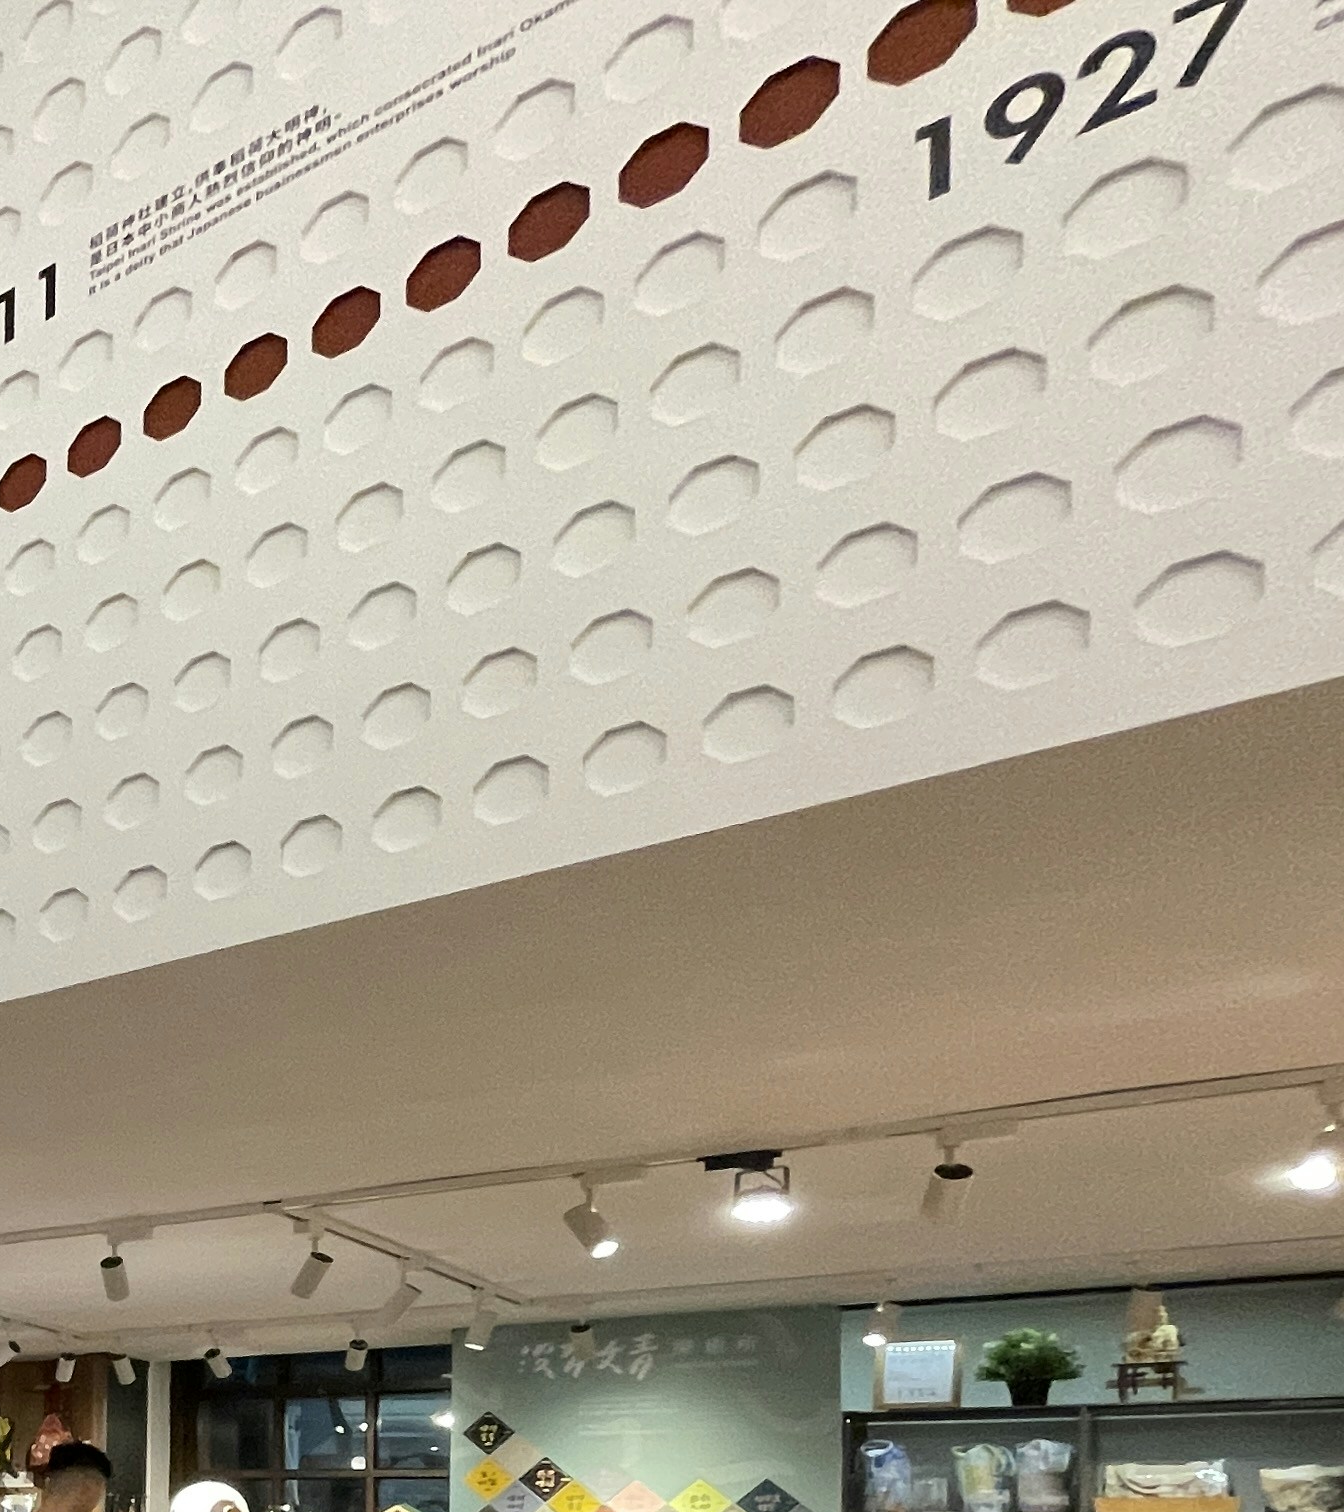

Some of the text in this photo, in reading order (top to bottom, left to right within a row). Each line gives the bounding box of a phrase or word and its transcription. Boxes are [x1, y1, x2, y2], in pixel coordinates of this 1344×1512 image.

[90, 254, 124, 280] Taipei
[128, 235, 156, 259] Inari
[160, 211, 202, 241] Shrine
[206, 193, 233, 213] was
[327, 114, 370, 144] which
[374, 51, 472, 117] consecrated
[478, 25, 516, 58] Inari
[159, 234, 184, 255] that
[187, 198, 252, 240] Japanese
[256, 140, 352, 201] businessmen
[356, 89, 444, 143] enterprises
[450, 46, 517, 91] worship
[915, 0, 1249, 200] 1927
